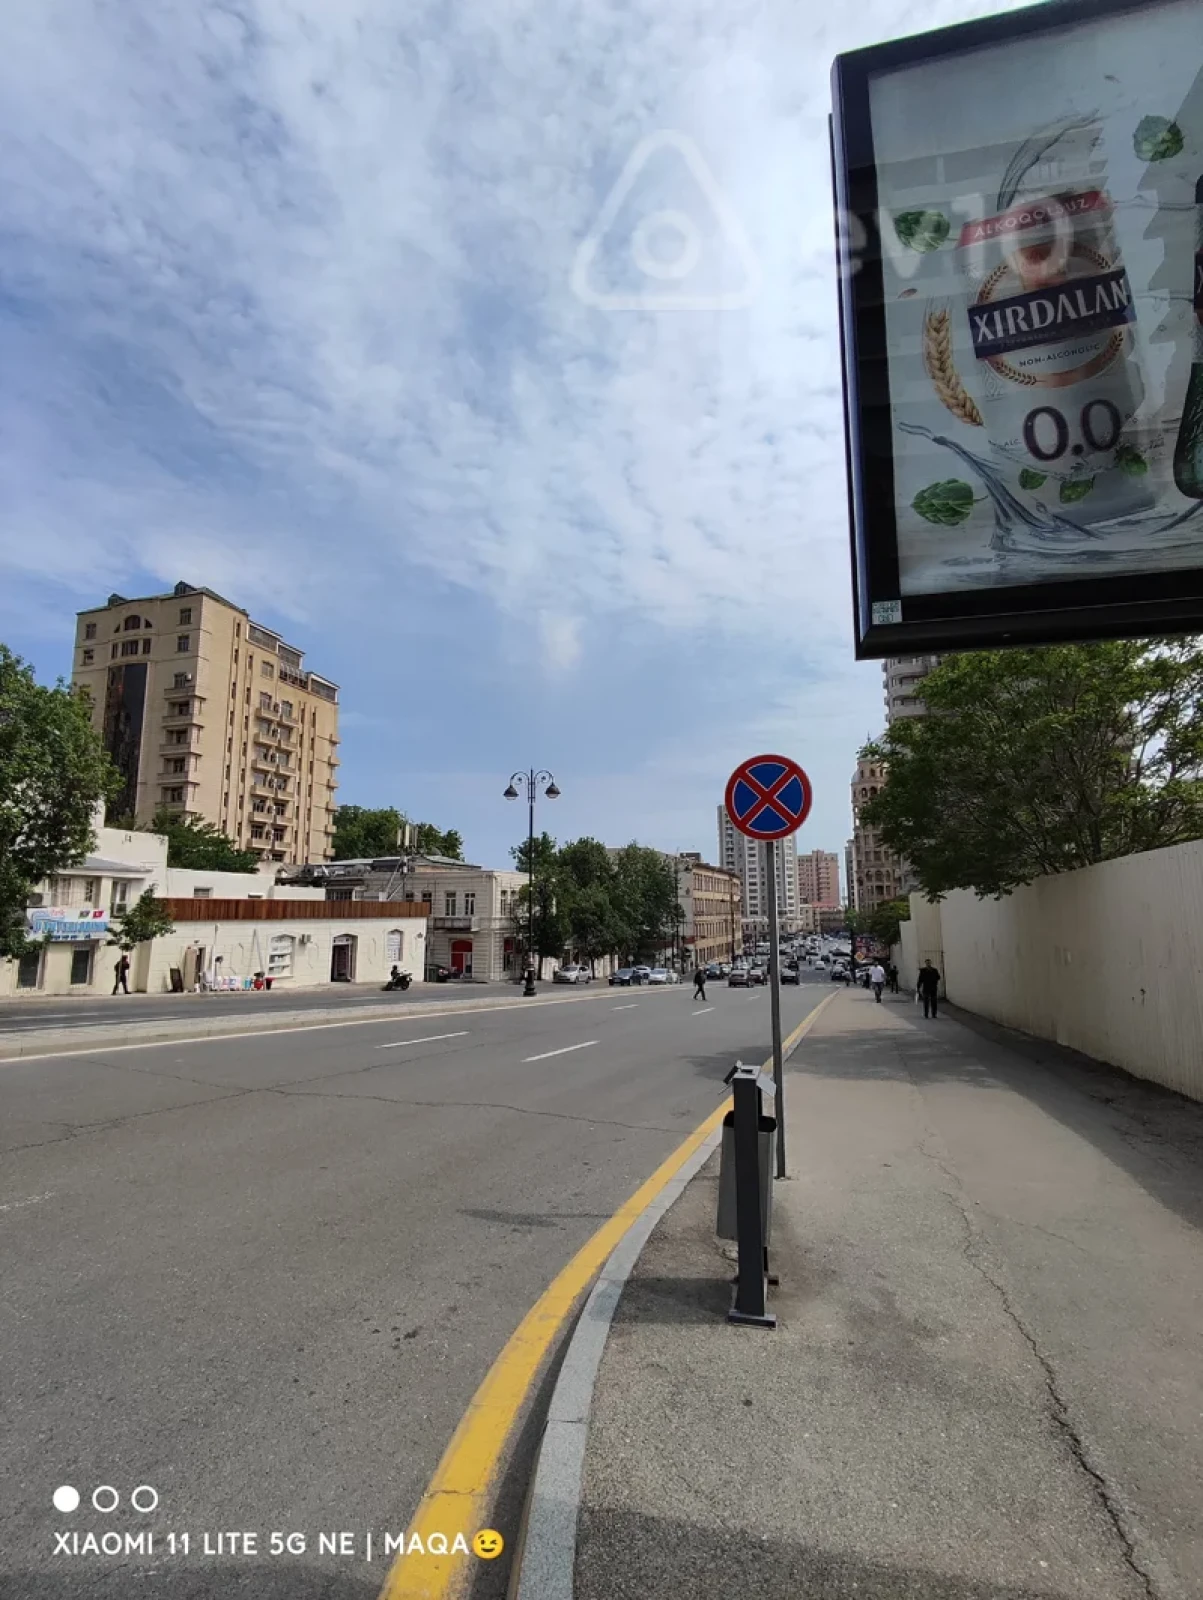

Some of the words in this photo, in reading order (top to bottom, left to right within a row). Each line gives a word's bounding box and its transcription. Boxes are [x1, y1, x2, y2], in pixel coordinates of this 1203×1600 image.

[974, 197, 1090, 239] ALKOQOLSUZ
[973, 278, 1129, 342] XIRDALAN
[1019, 342, 1101, 367] NON-ALCOHOLIC
